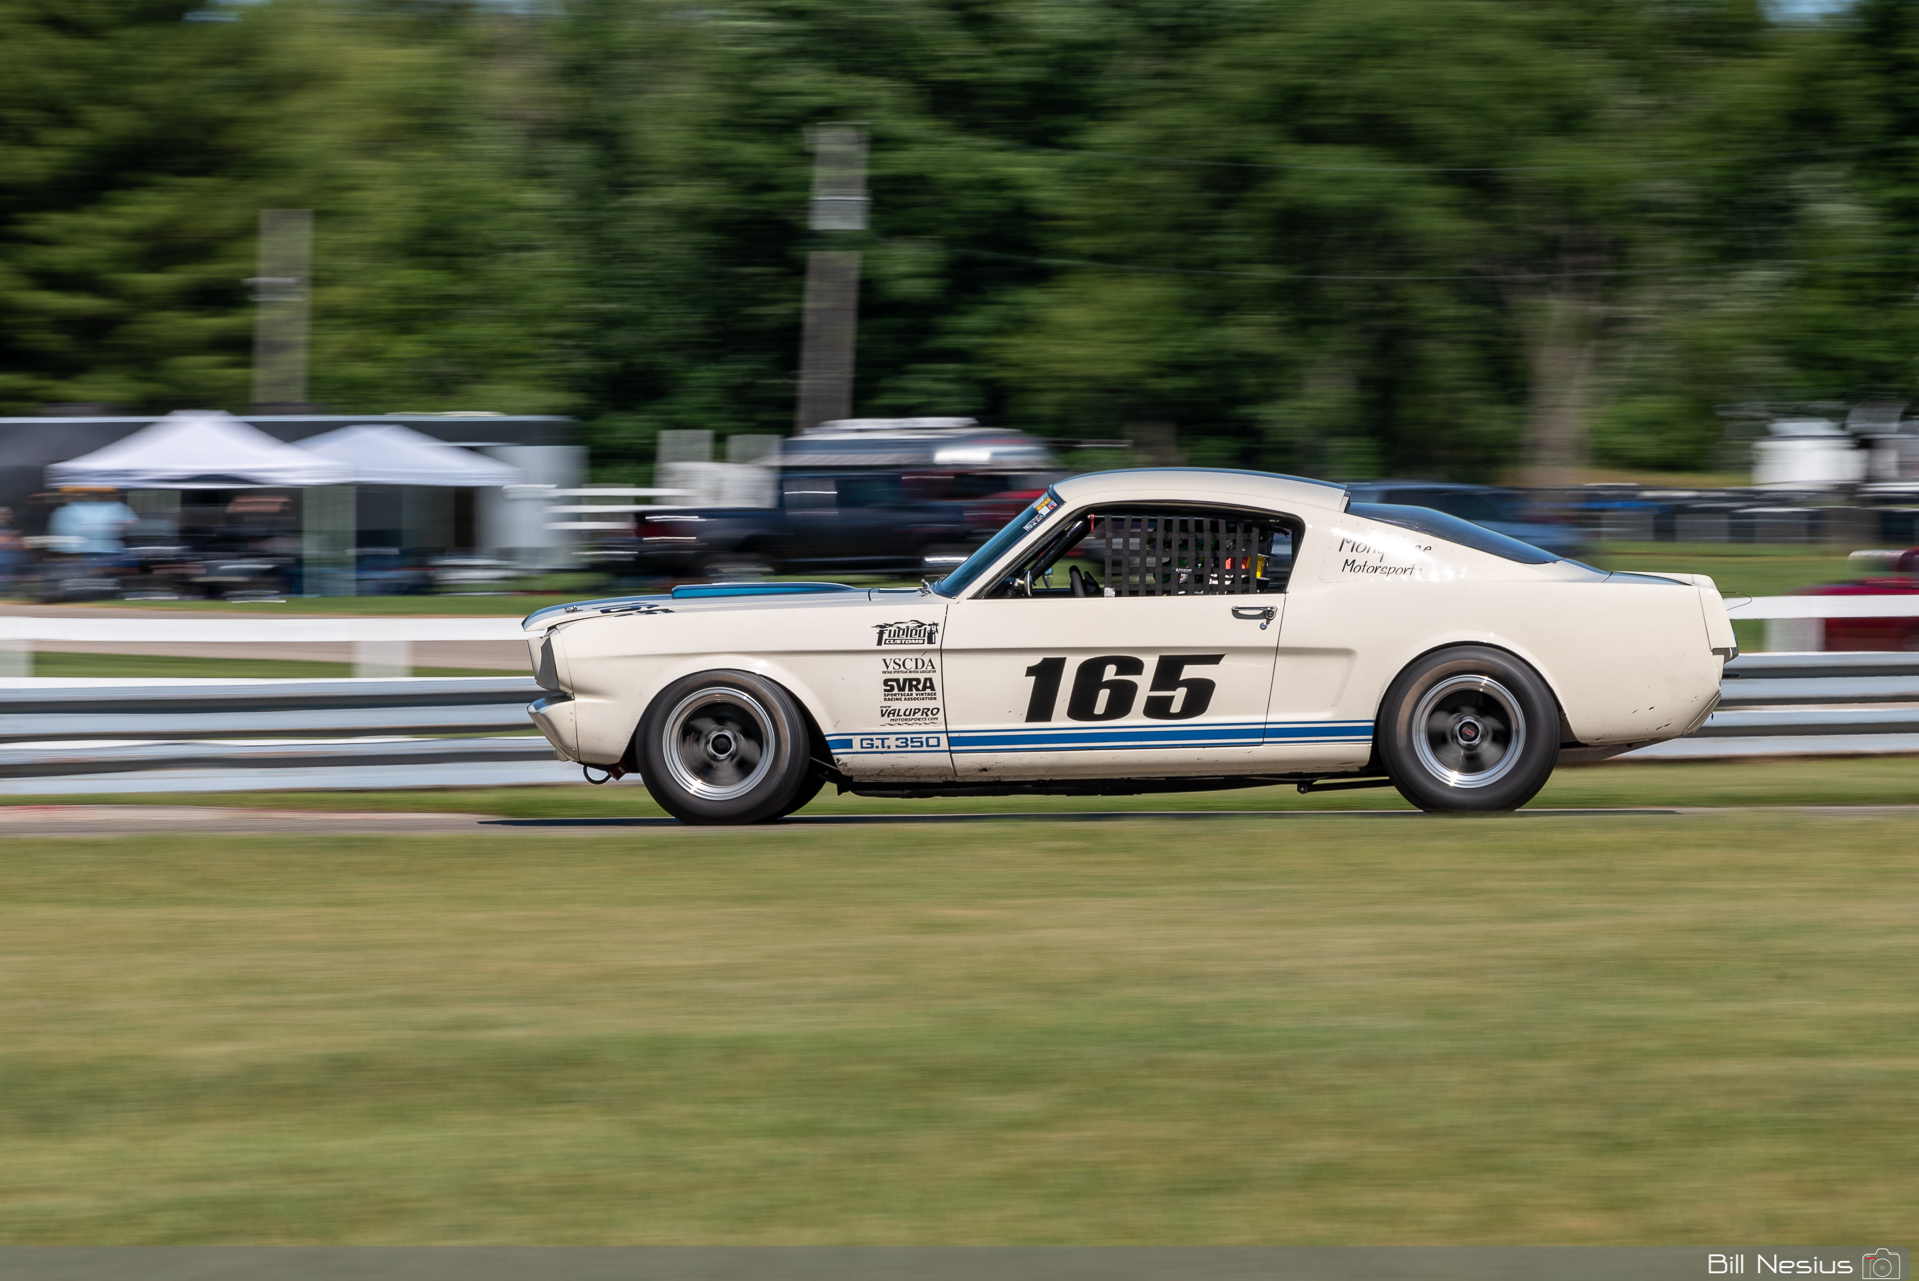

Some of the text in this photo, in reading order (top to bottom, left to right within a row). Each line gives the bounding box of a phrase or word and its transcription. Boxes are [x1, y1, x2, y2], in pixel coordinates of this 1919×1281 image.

[1341, 558, 1423, 577] Motorsport
[882, 658, 936, 670] VSCDA
[883, 677, 936, 692] SVRA
[1024, 653, 1227, 722] 165
[880, 707, 940, 718] VALUPRO
[895, 736, 941, 748] 350
